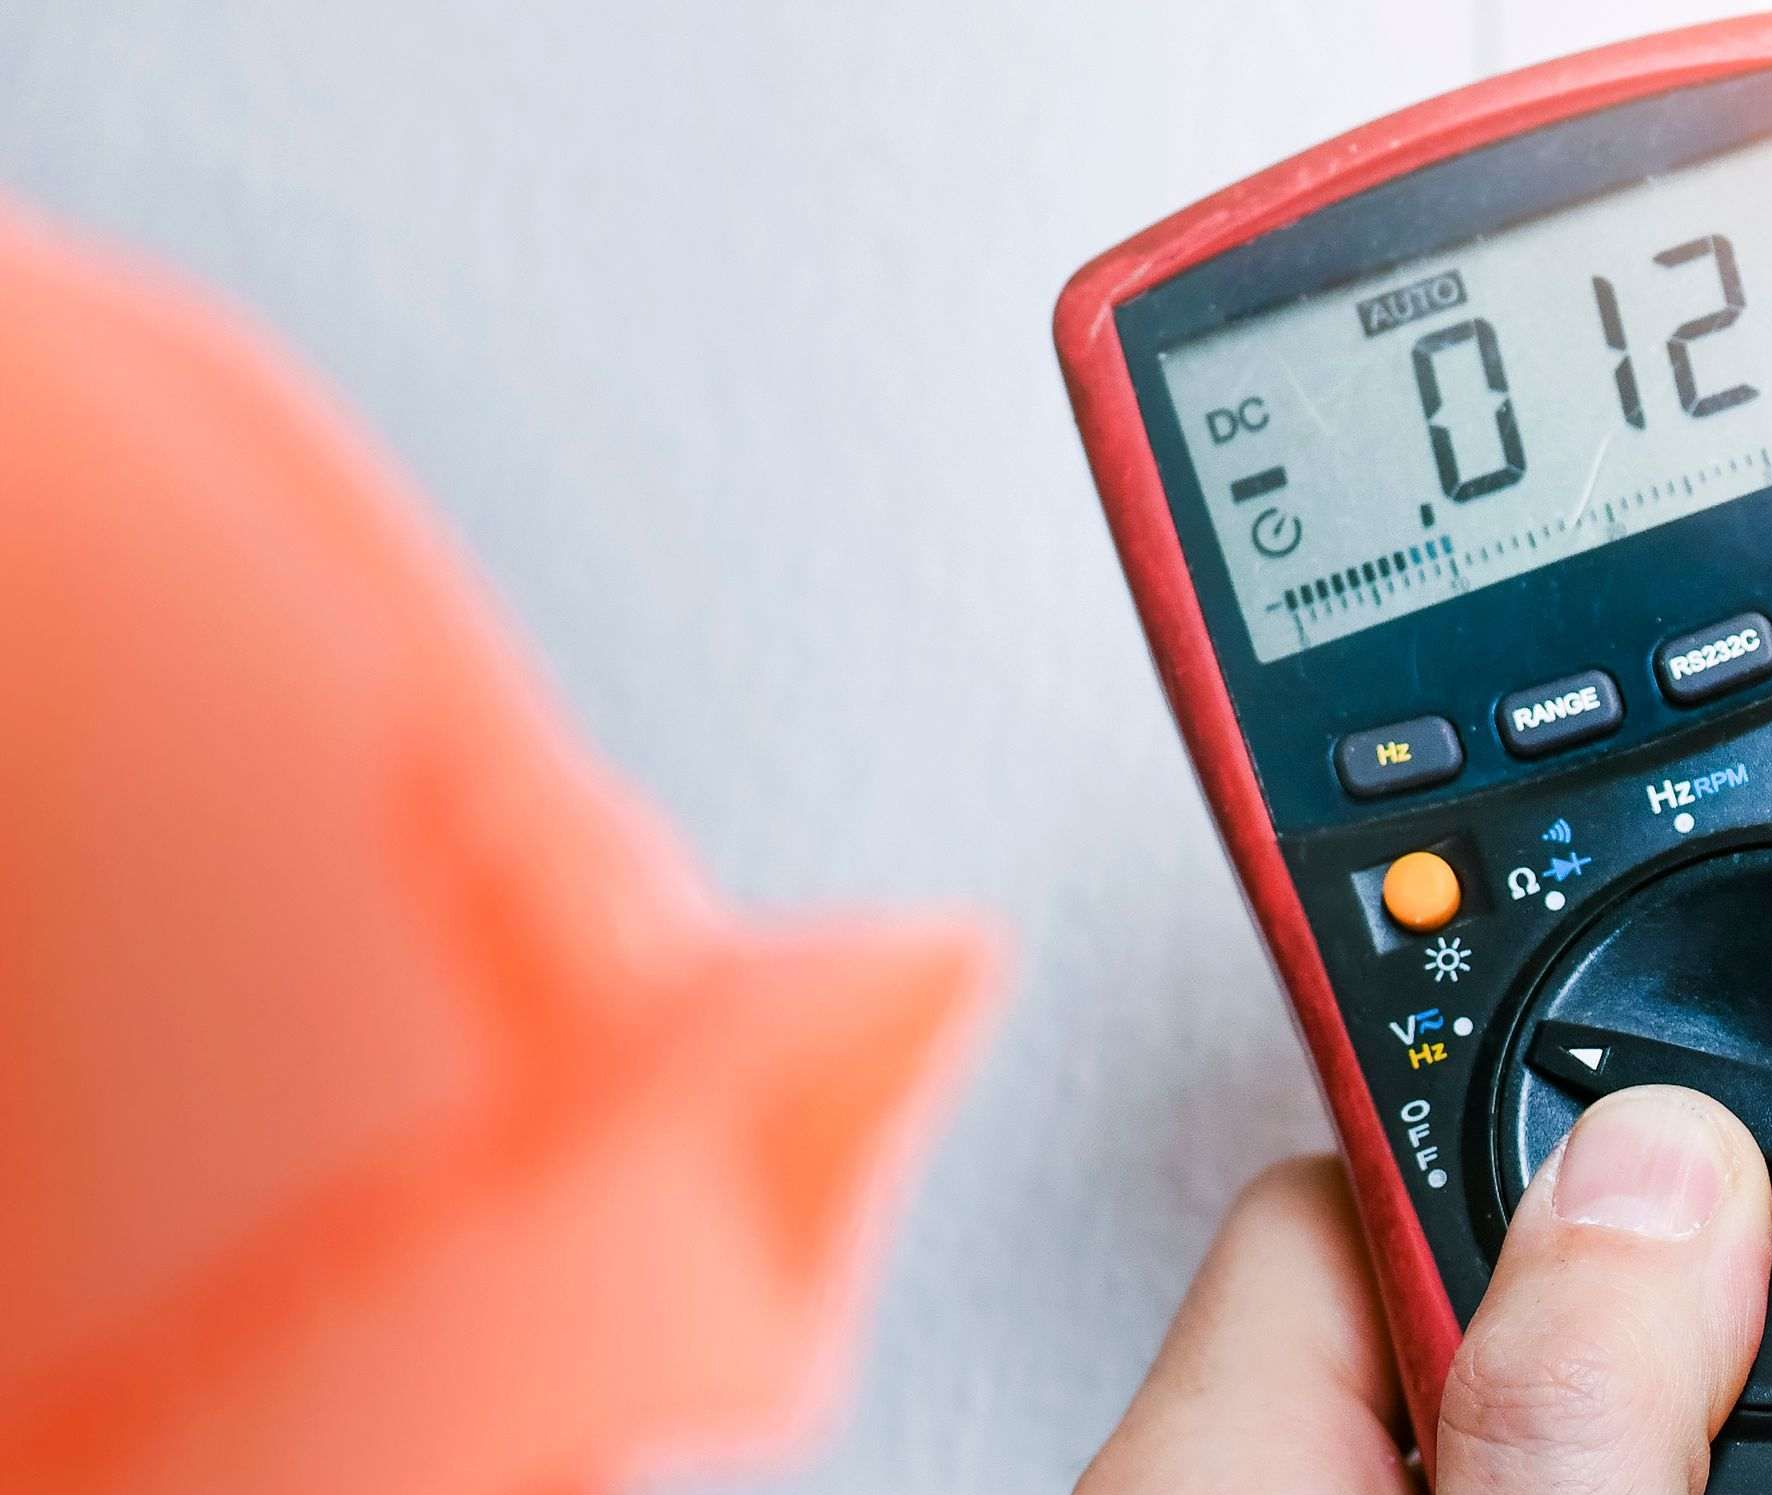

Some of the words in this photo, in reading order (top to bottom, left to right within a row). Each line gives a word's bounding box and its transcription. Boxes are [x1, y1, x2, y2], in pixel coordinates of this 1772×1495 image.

[1364, 274, 1462, 334] AUTO
[1205, 396, 1270, 445] DC
[1669, 628, 1761, 680] RS232C
[1512, 686, 1601, 732] RANGE
[1376, 741, 1412, 766] Hz
[1408, 1042, 1448, 1070] Hz
[1400, 1099, 1439, 1171] OFF
